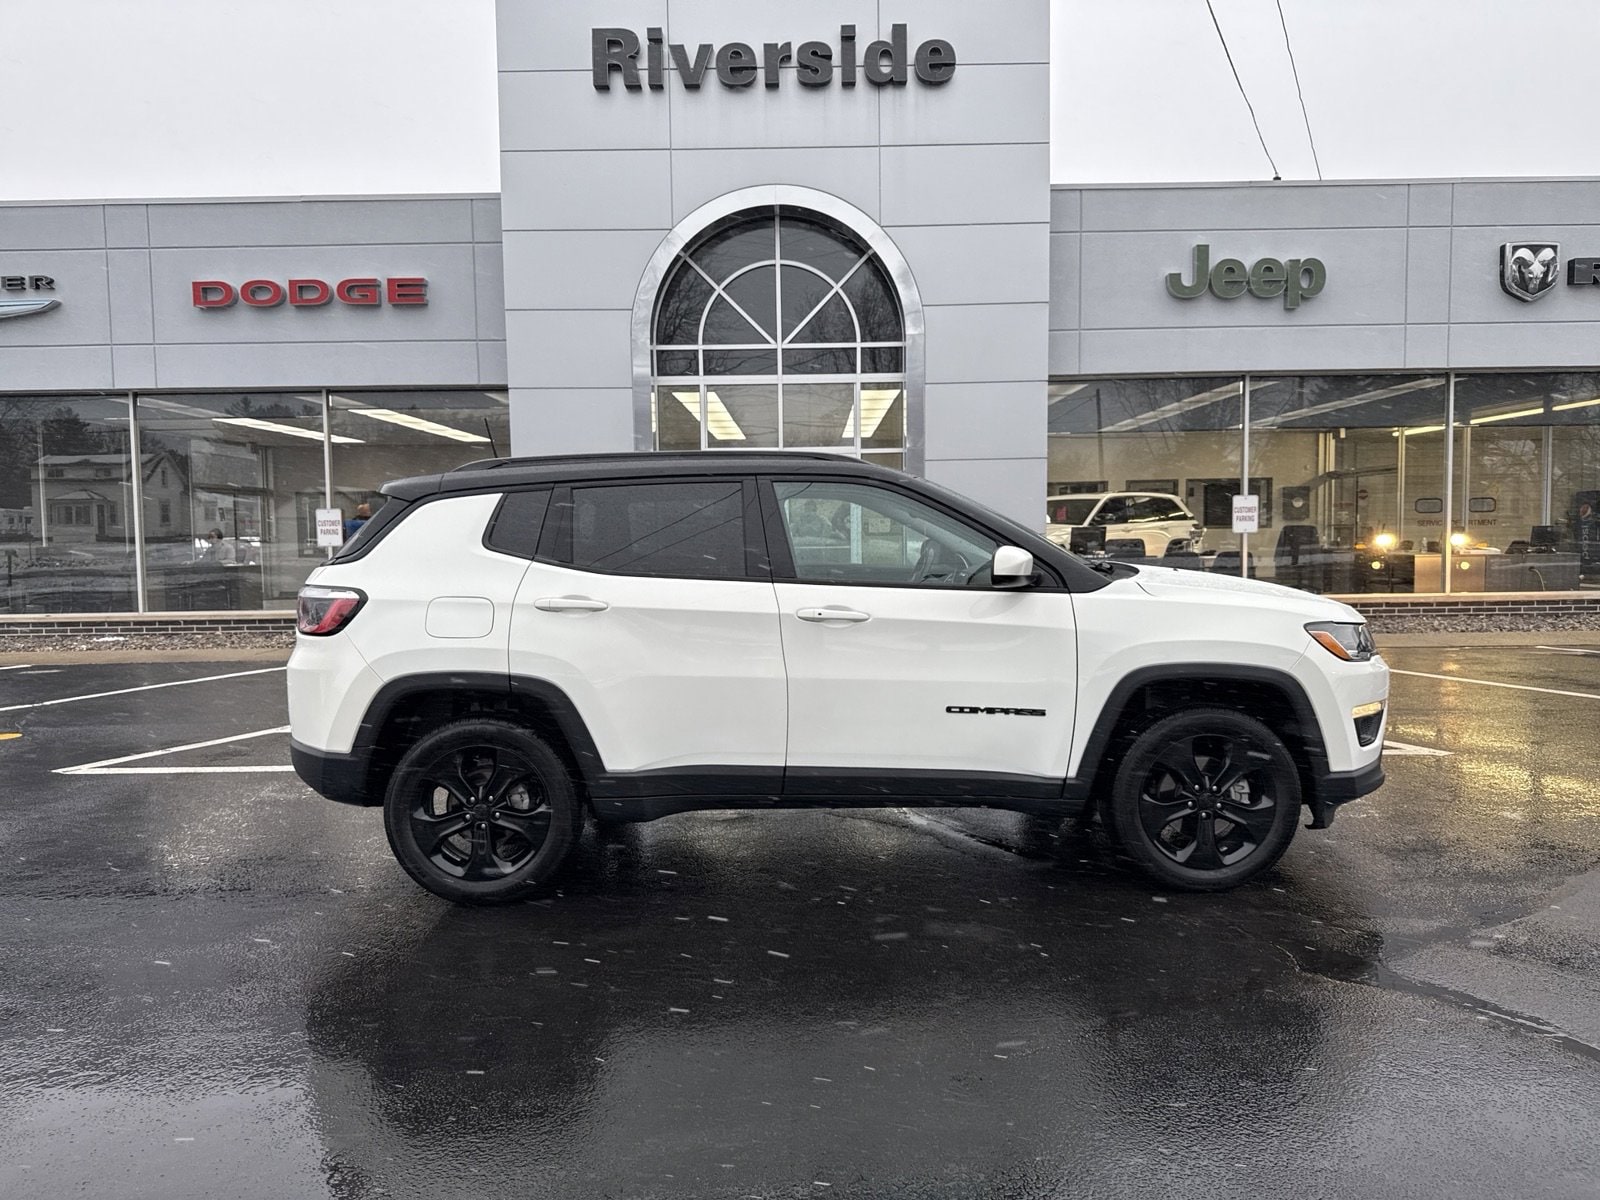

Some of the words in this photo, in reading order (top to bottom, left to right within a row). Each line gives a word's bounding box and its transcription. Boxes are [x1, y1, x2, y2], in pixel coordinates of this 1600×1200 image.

[592, 24, 956, 89] Riverside
[1166, 243, 1326, 309] Jeep
[192, 277, 429, 309] DODGE
[317, 519, 341, 527] CUSTOMER
[1416, 519, 1446, 527] SERVIC
[320, 528, 339, 536] PARKING
[946, 705, 1046, 717] COMPASS
